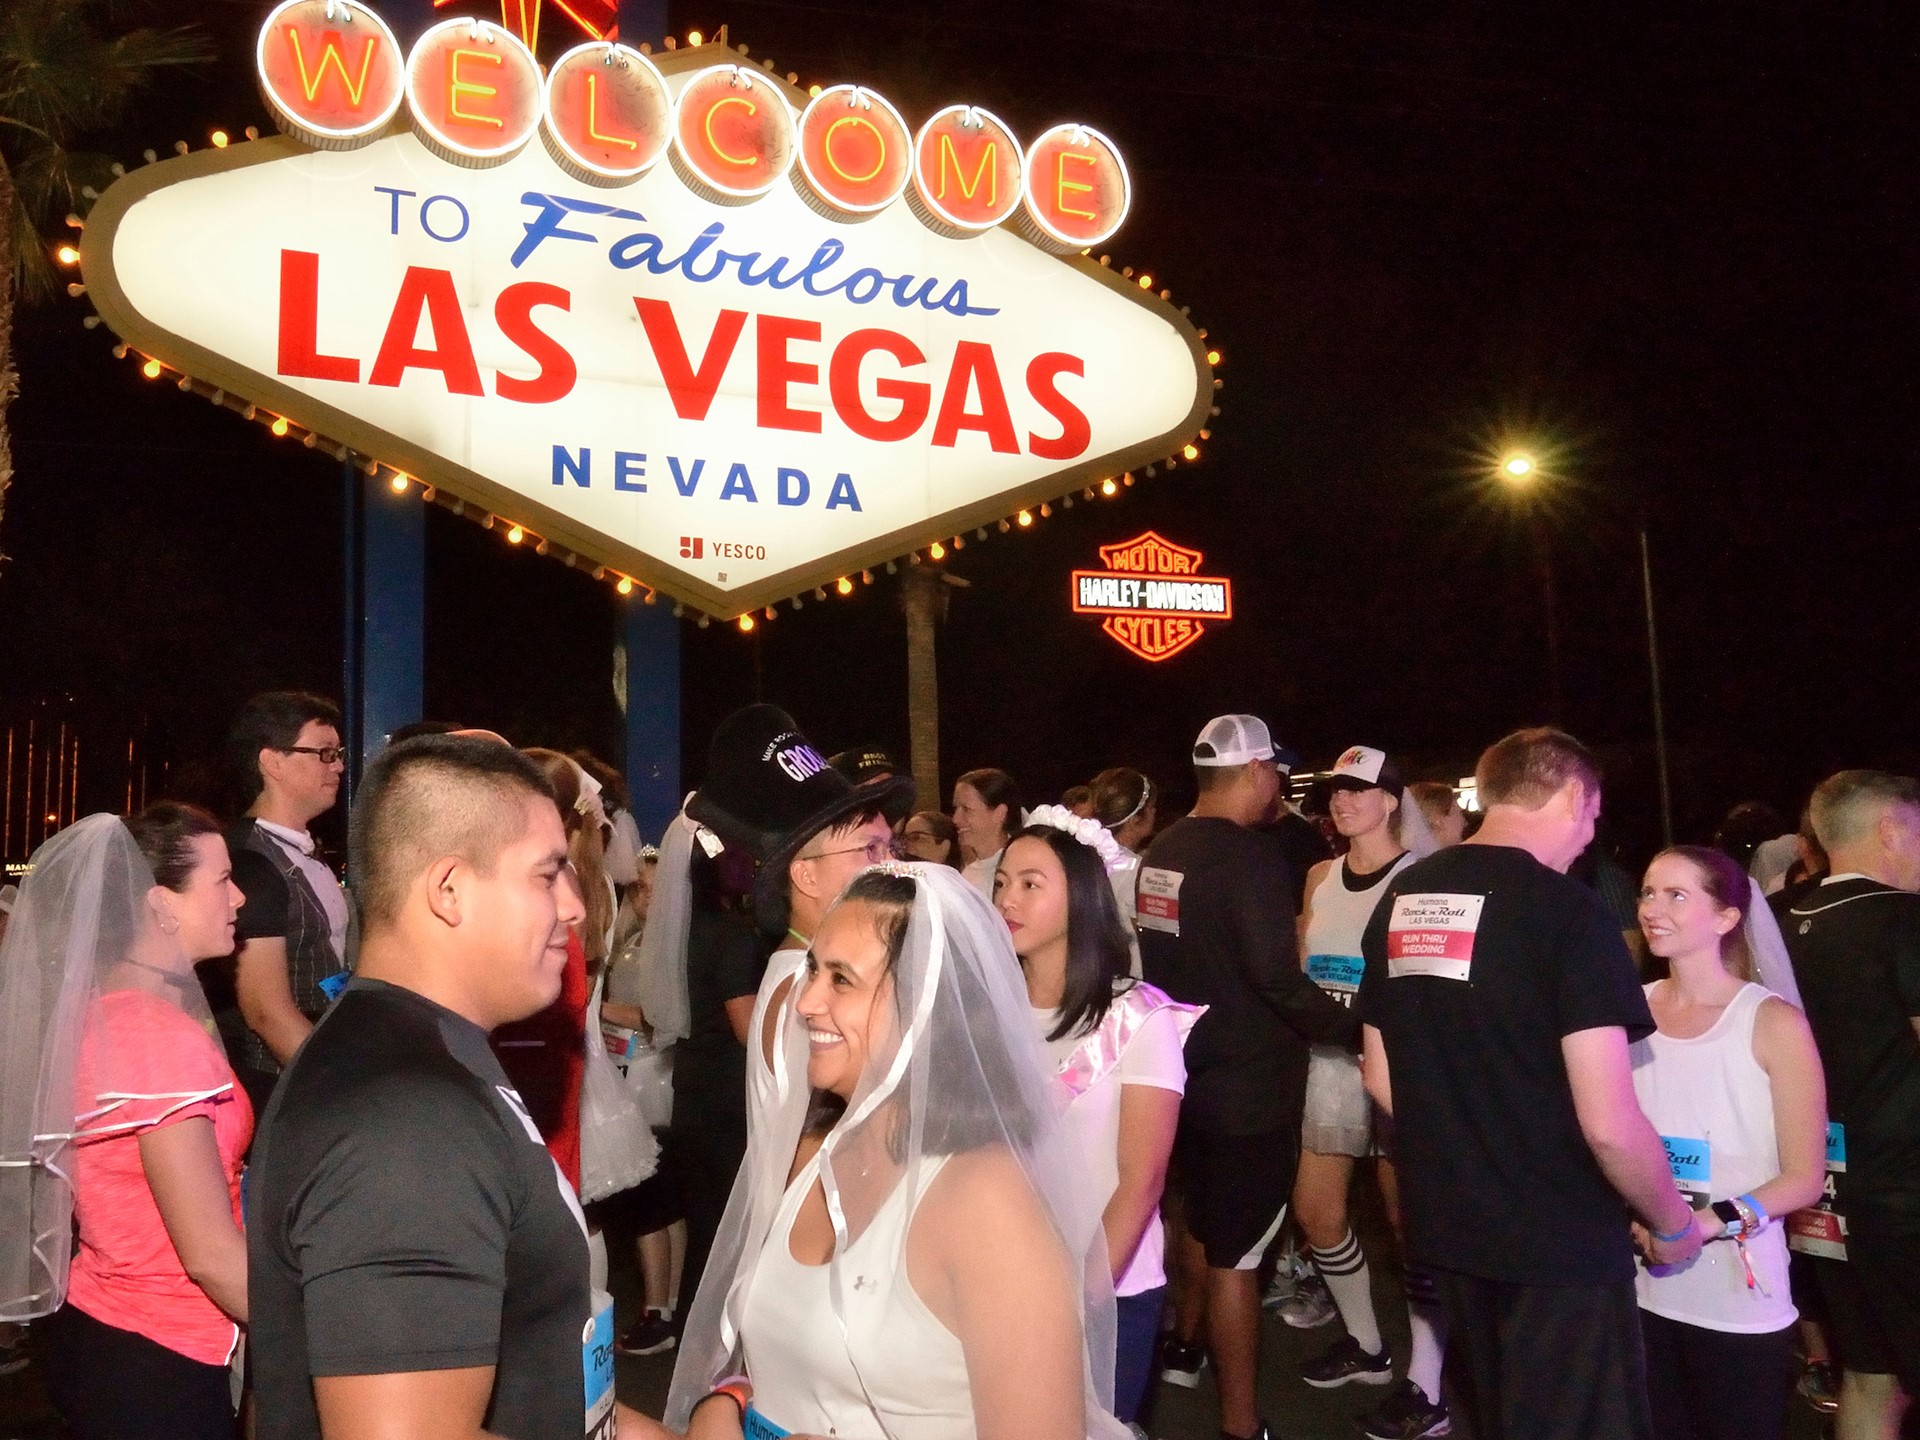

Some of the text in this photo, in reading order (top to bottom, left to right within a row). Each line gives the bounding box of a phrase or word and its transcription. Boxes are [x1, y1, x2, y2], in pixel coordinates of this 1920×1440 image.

[286, 24, 1097, 222] WELCOME
[374, 186, 1001, 318] TO Fabulous
[277, 248, 1092, 461] LAS VEGAS
[551, 444, 864, 513] NEVADA
[712, 541, 767, 561] YESCO
[1112, 539, 1191, 575] MOTOR
[1079, 577, 1225, 613] HARLEY-DAVIDSON
[1113, 616, 1192, 654] CYCLES
[1401, 907, 1428, 917] Rock
[1438, 906, 1466, 917] Roll
[1417, 898, 1449, 906] Humana
[1401, 933, 1448, 943] RUN THRU
[1408, 917, 1450, 925] LAS VEGAS
[1401, 944, 1446, 954] WEDDING
